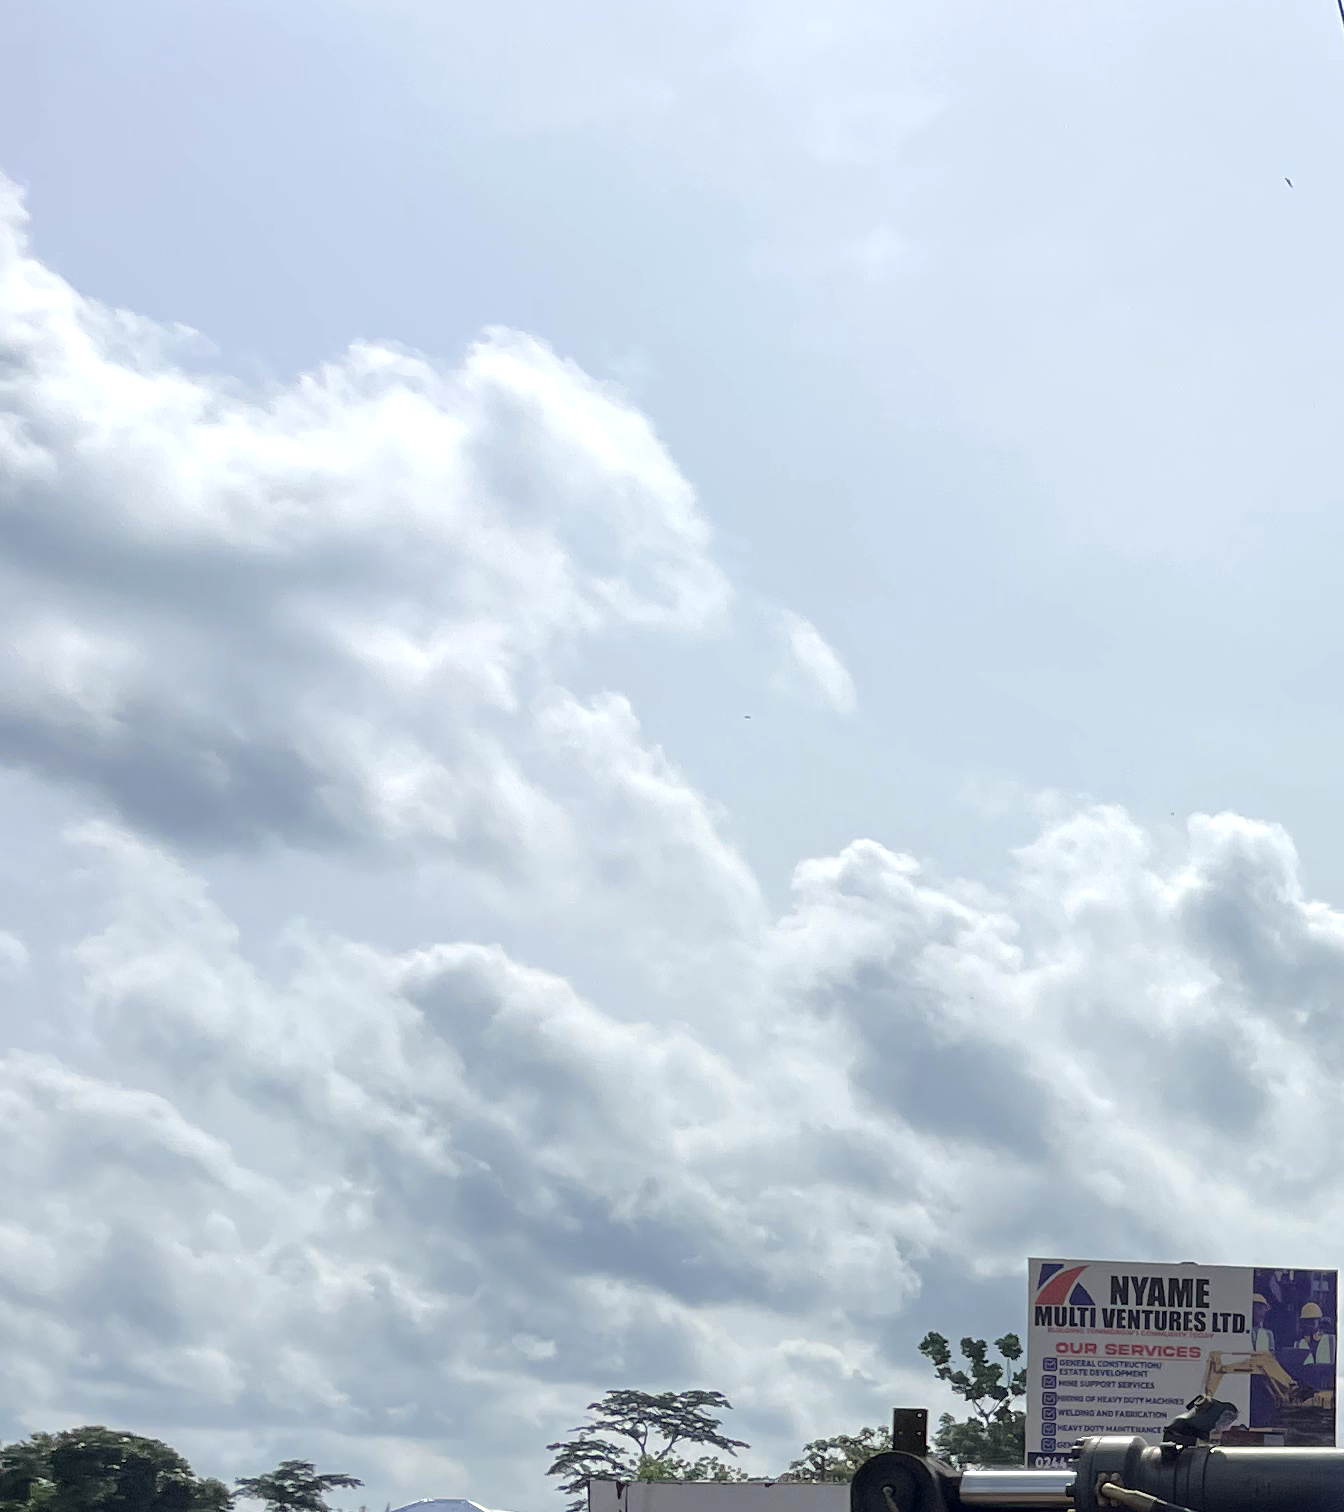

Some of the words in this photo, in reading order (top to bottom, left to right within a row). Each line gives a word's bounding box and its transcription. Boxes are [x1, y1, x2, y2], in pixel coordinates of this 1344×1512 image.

[1110, 1275, 1210, 1309] NYAME
[1034, 1305, 1096, 1328] MULTI
[1101, 1307, 1207, 1332] VENTURES
[1212, 1312, 1250, 1334] LTD.
[1056, 1342, 1098, 1355] OUR
[1104, 1343, 1202, 1359] SERVICES
[1059, 1359, 1097, 1368] GENERAL
[1059, 1368, 1088, 1377] ESTATE
[1089, 1368, 1149, 1378] DEVELOPMENT
[1080, 1380, 1117, 1389] SUPPORT
[1117, 1381, 1155, 1390] SERVICES
[1085, 1395, 1096, 1403] OF
[1097, 1396, 1123, 1404] HEAVY
[1123, 1397, 1145, 1405] DUTY
[1145, 1397, 1185, 1406] MACHINES
[1058, 1409, 1095, 1417] WELDING
[1096, 1410, 1114, 1418] AND
[1114, 1410, 1168, 1419] FABRICATION
[1057, 1424, 1083, 1432] HEAVY
[1084, 1425, 1105, 1433] DUTY
[1105, 1425, 1162, 1434] MAINTENANCE
